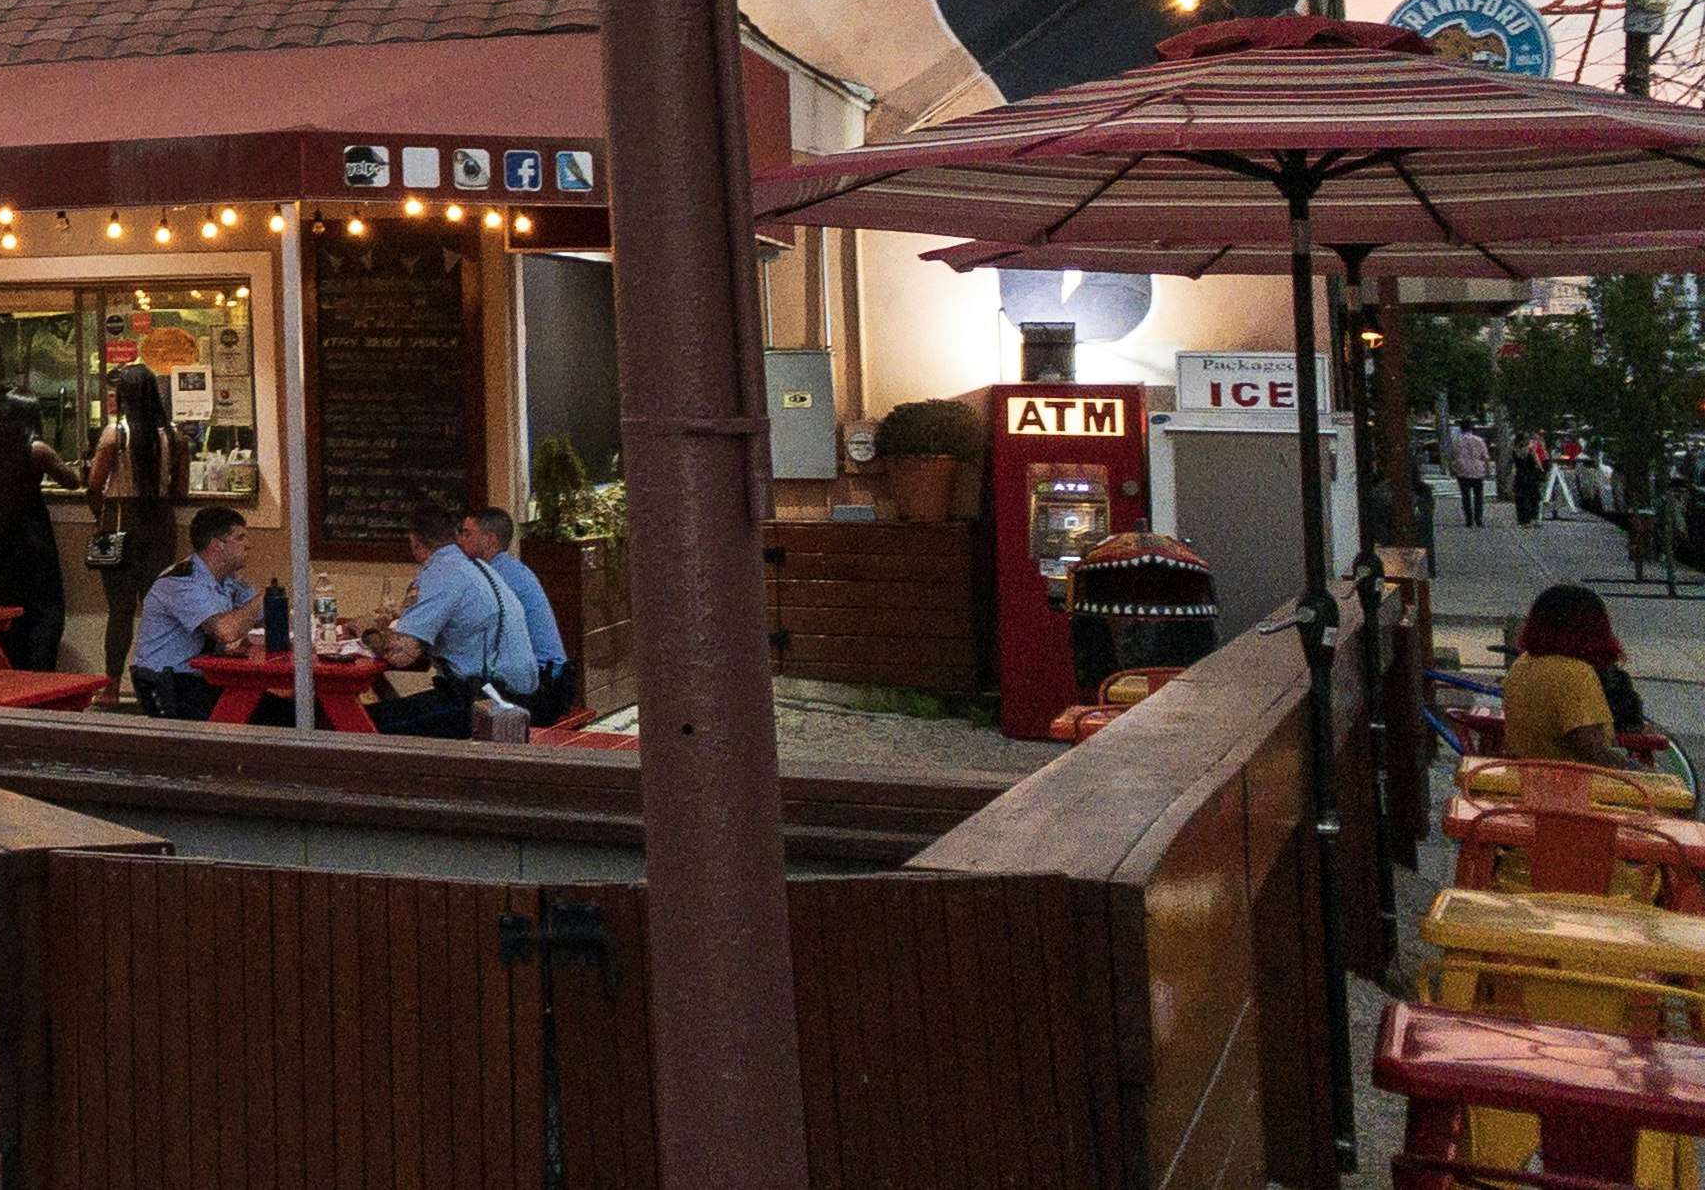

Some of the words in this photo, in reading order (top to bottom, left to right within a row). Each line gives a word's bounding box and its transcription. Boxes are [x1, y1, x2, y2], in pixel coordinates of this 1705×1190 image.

[1210, 381, 1294, 407] ICE
[1016, 400, 1117, 434] ATM
[1053, 483, 1090, 492] ATM
